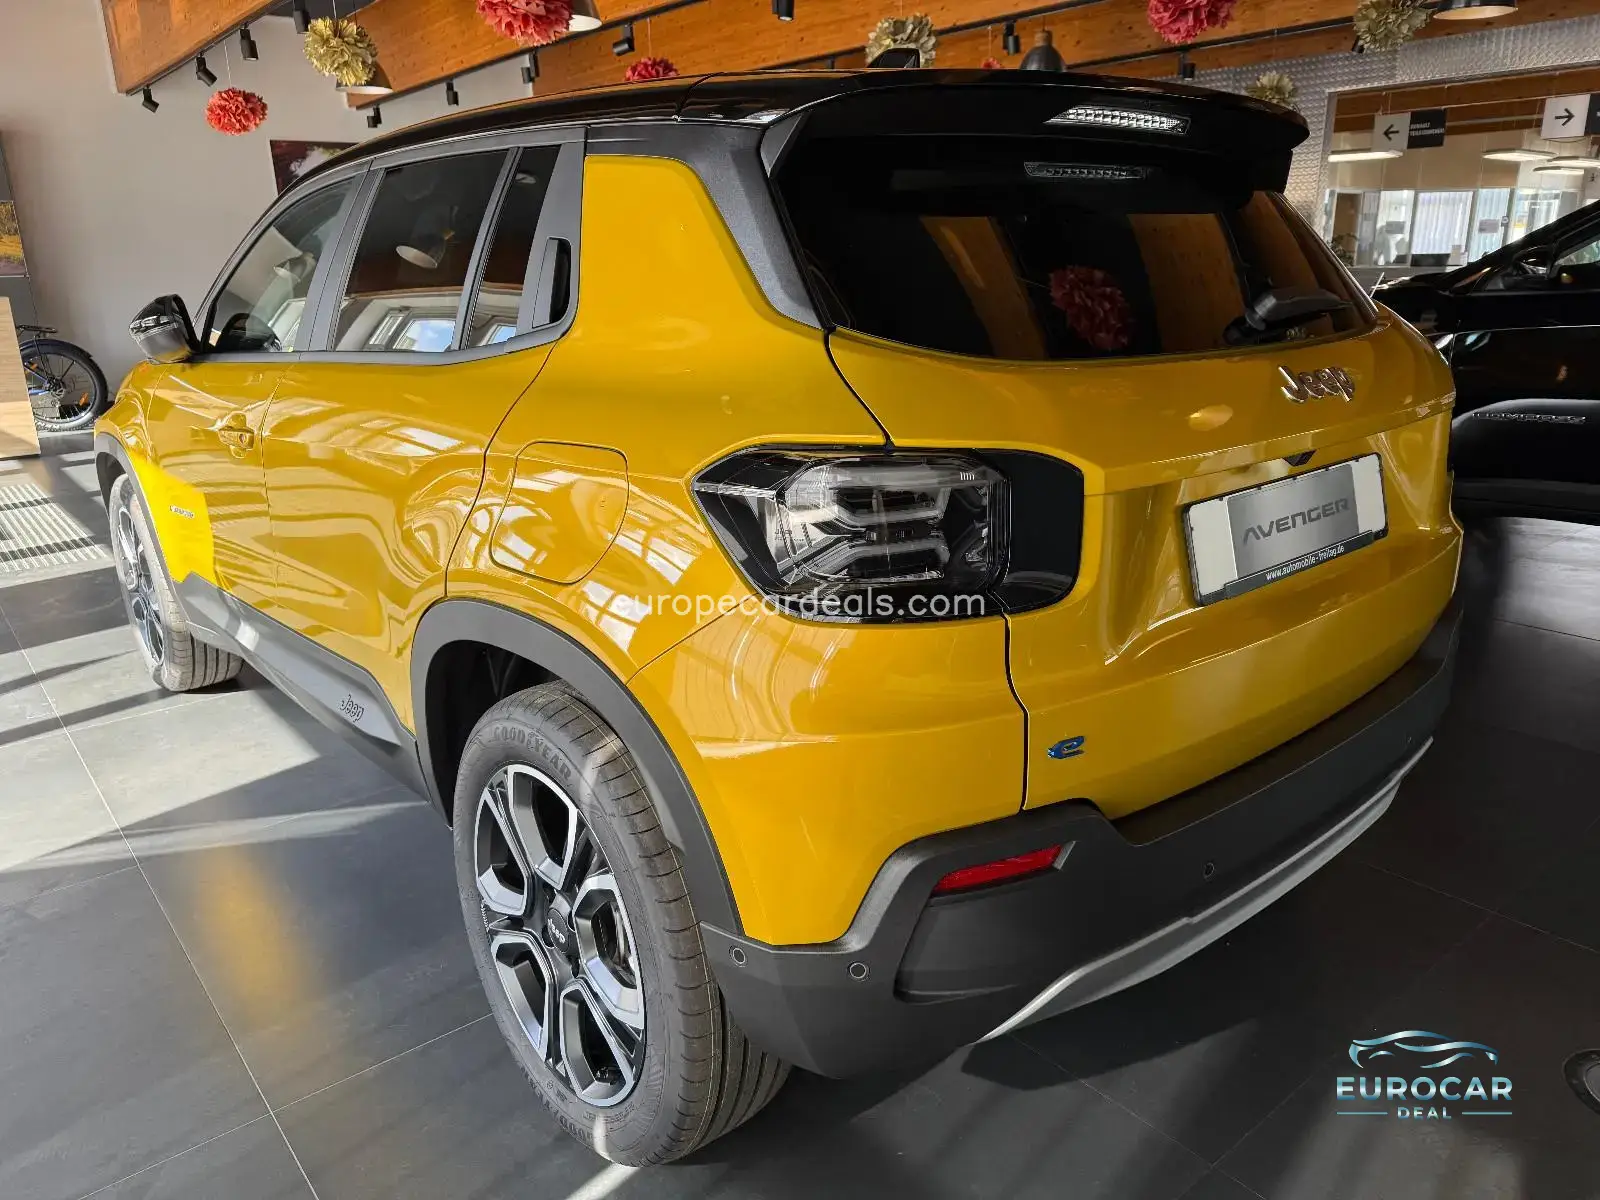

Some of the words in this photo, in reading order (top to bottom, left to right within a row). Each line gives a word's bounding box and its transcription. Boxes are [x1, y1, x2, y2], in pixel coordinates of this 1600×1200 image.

[1278, 365, 1356, 403] Jeep
[1241, 498, 1351, 546] AVENGER
[339, 693, 365, 723] Jeep
[493, 725, 572, 780] GOODYEAR
